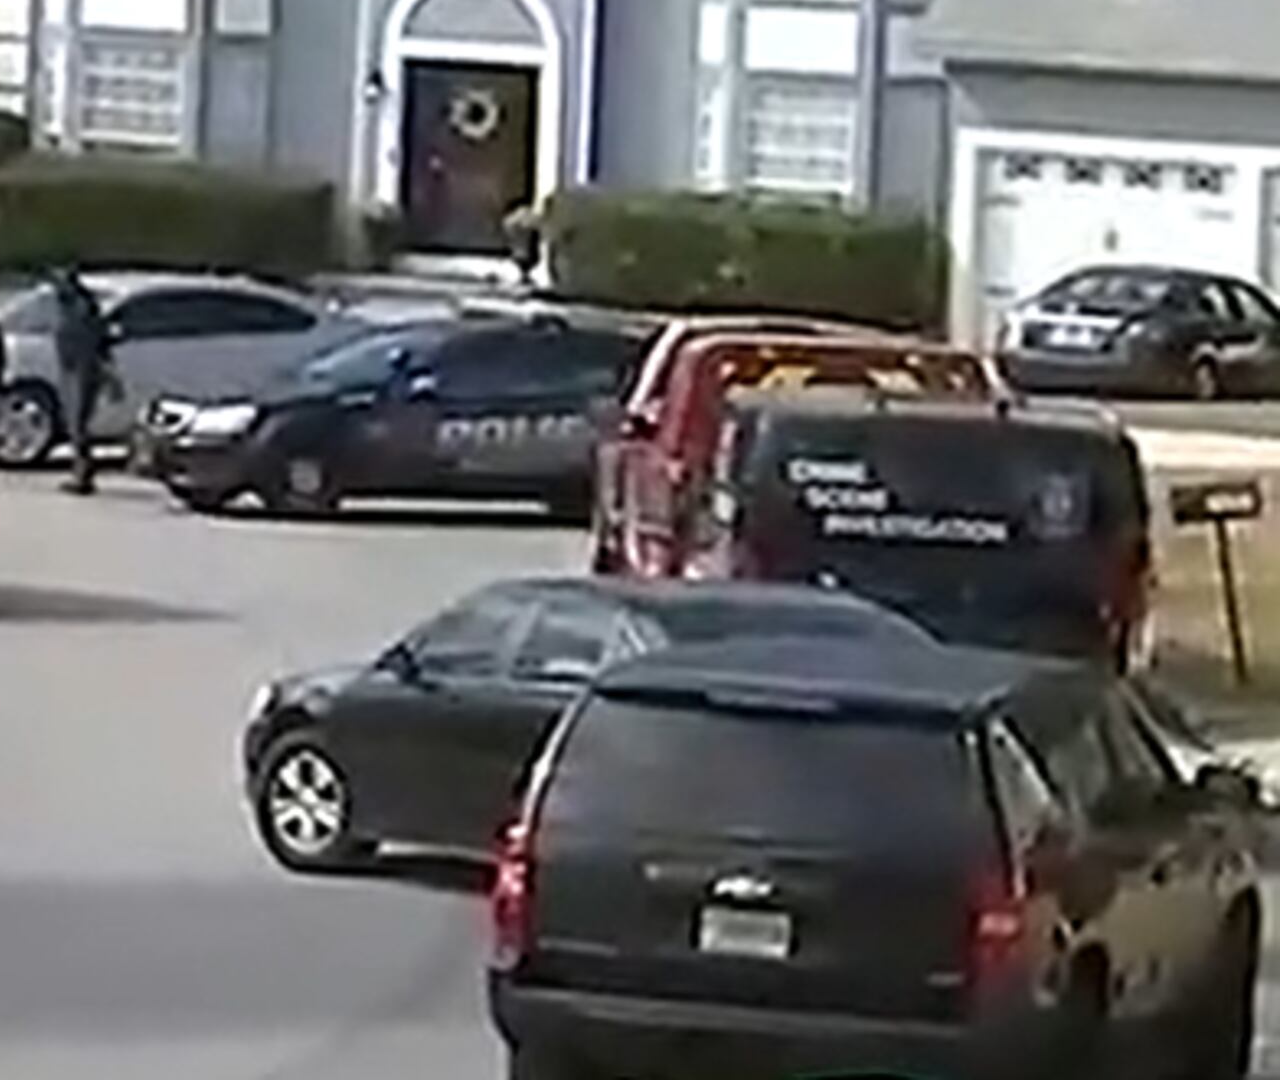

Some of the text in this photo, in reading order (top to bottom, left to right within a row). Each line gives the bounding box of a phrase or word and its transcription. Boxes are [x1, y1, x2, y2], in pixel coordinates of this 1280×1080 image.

[788, 458, 867, 484] CRIME
[804, 486, 887, 511] SCENE
[823, 513, 1008, 542] INVESTIGATION
